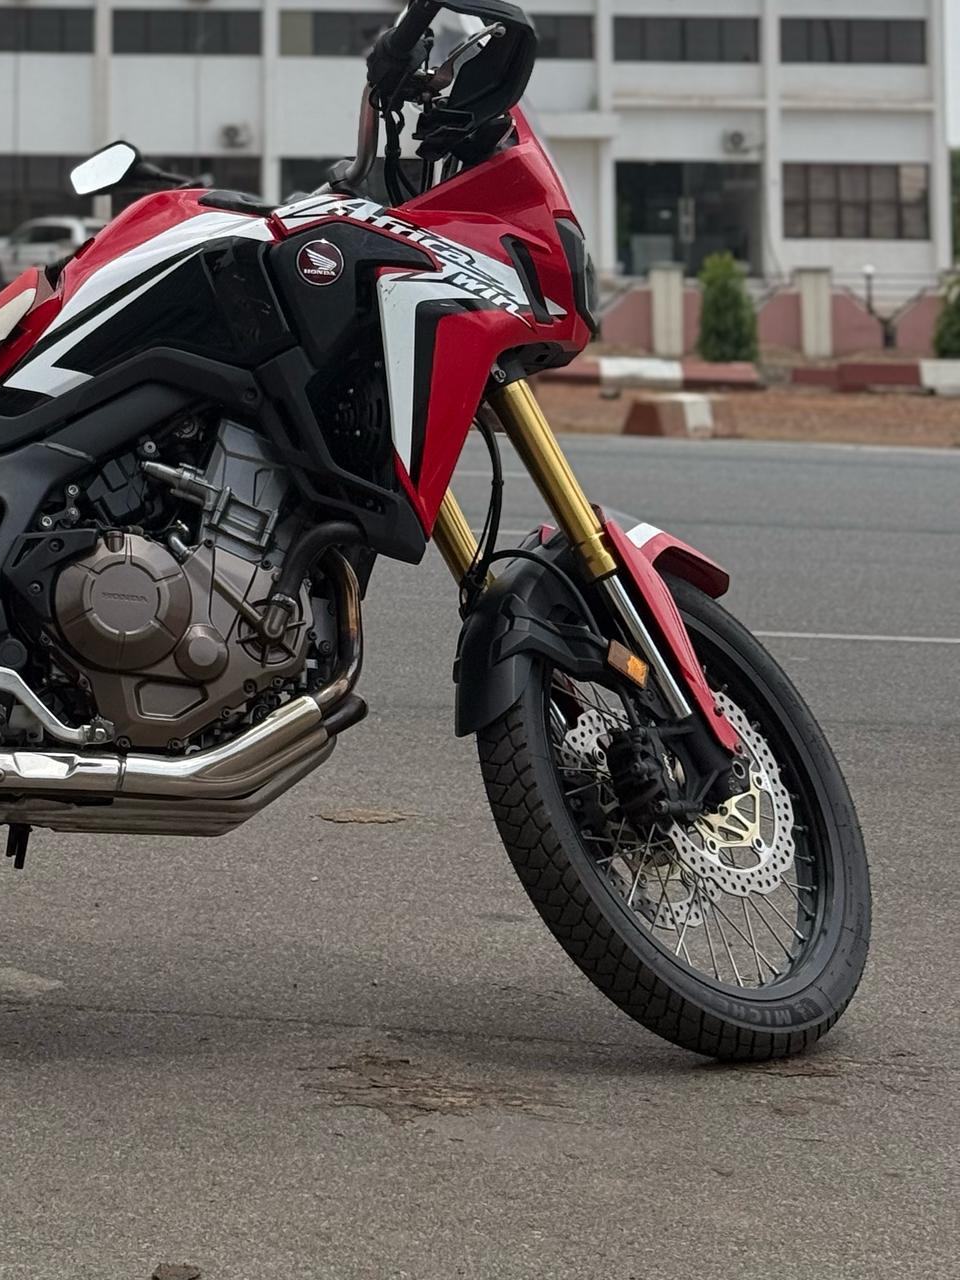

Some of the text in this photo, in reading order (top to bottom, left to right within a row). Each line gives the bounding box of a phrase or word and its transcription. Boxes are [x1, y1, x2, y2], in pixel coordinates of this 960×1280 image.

[328, 198, 476, 268] Africa
[303, 268, 337, 276] HONDA
[101, 591, 149, 604] HONDA
